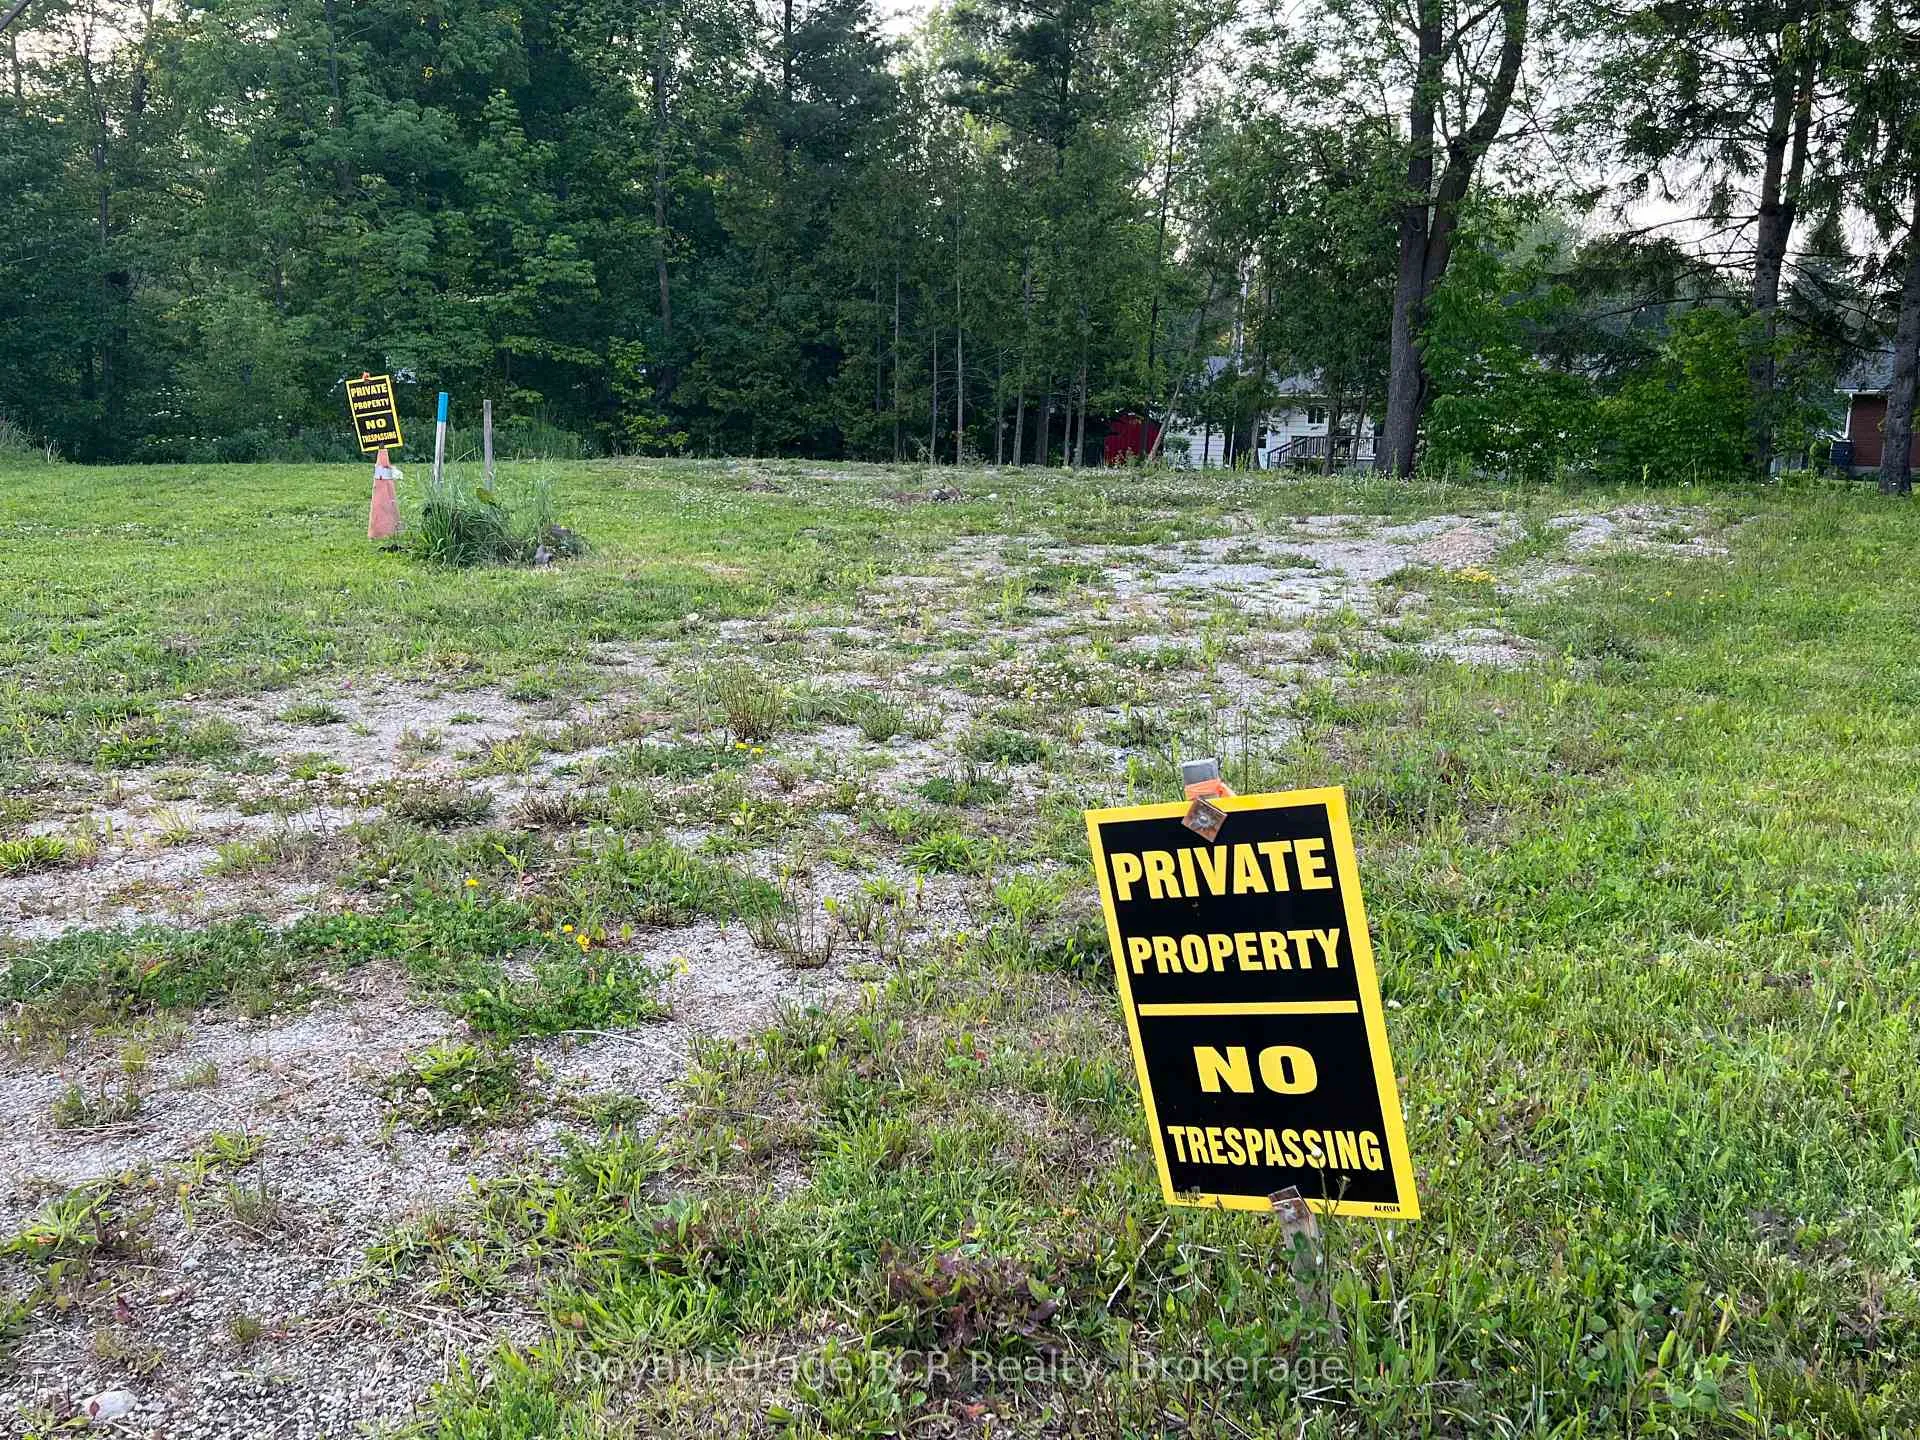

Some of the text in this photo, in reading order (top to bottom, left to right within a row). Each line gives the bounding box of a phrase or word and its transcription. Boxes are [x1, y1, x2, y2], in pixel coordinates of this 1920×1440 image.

[351, 384, 387, 398] PRIVATE
[354, 398, 389, 410] PROPERTY
[362, 432, 397, 443] TRESPASSING
[365, 418, 387, 430] NO
[1110, 837, 1333, 901] PRIVATE
[1127, 928, 1341, 974] PROPERTY
[1193, 1045, 1318, 1095] NO
[1167, 1125, 1385, 1171] TRESPASSING
